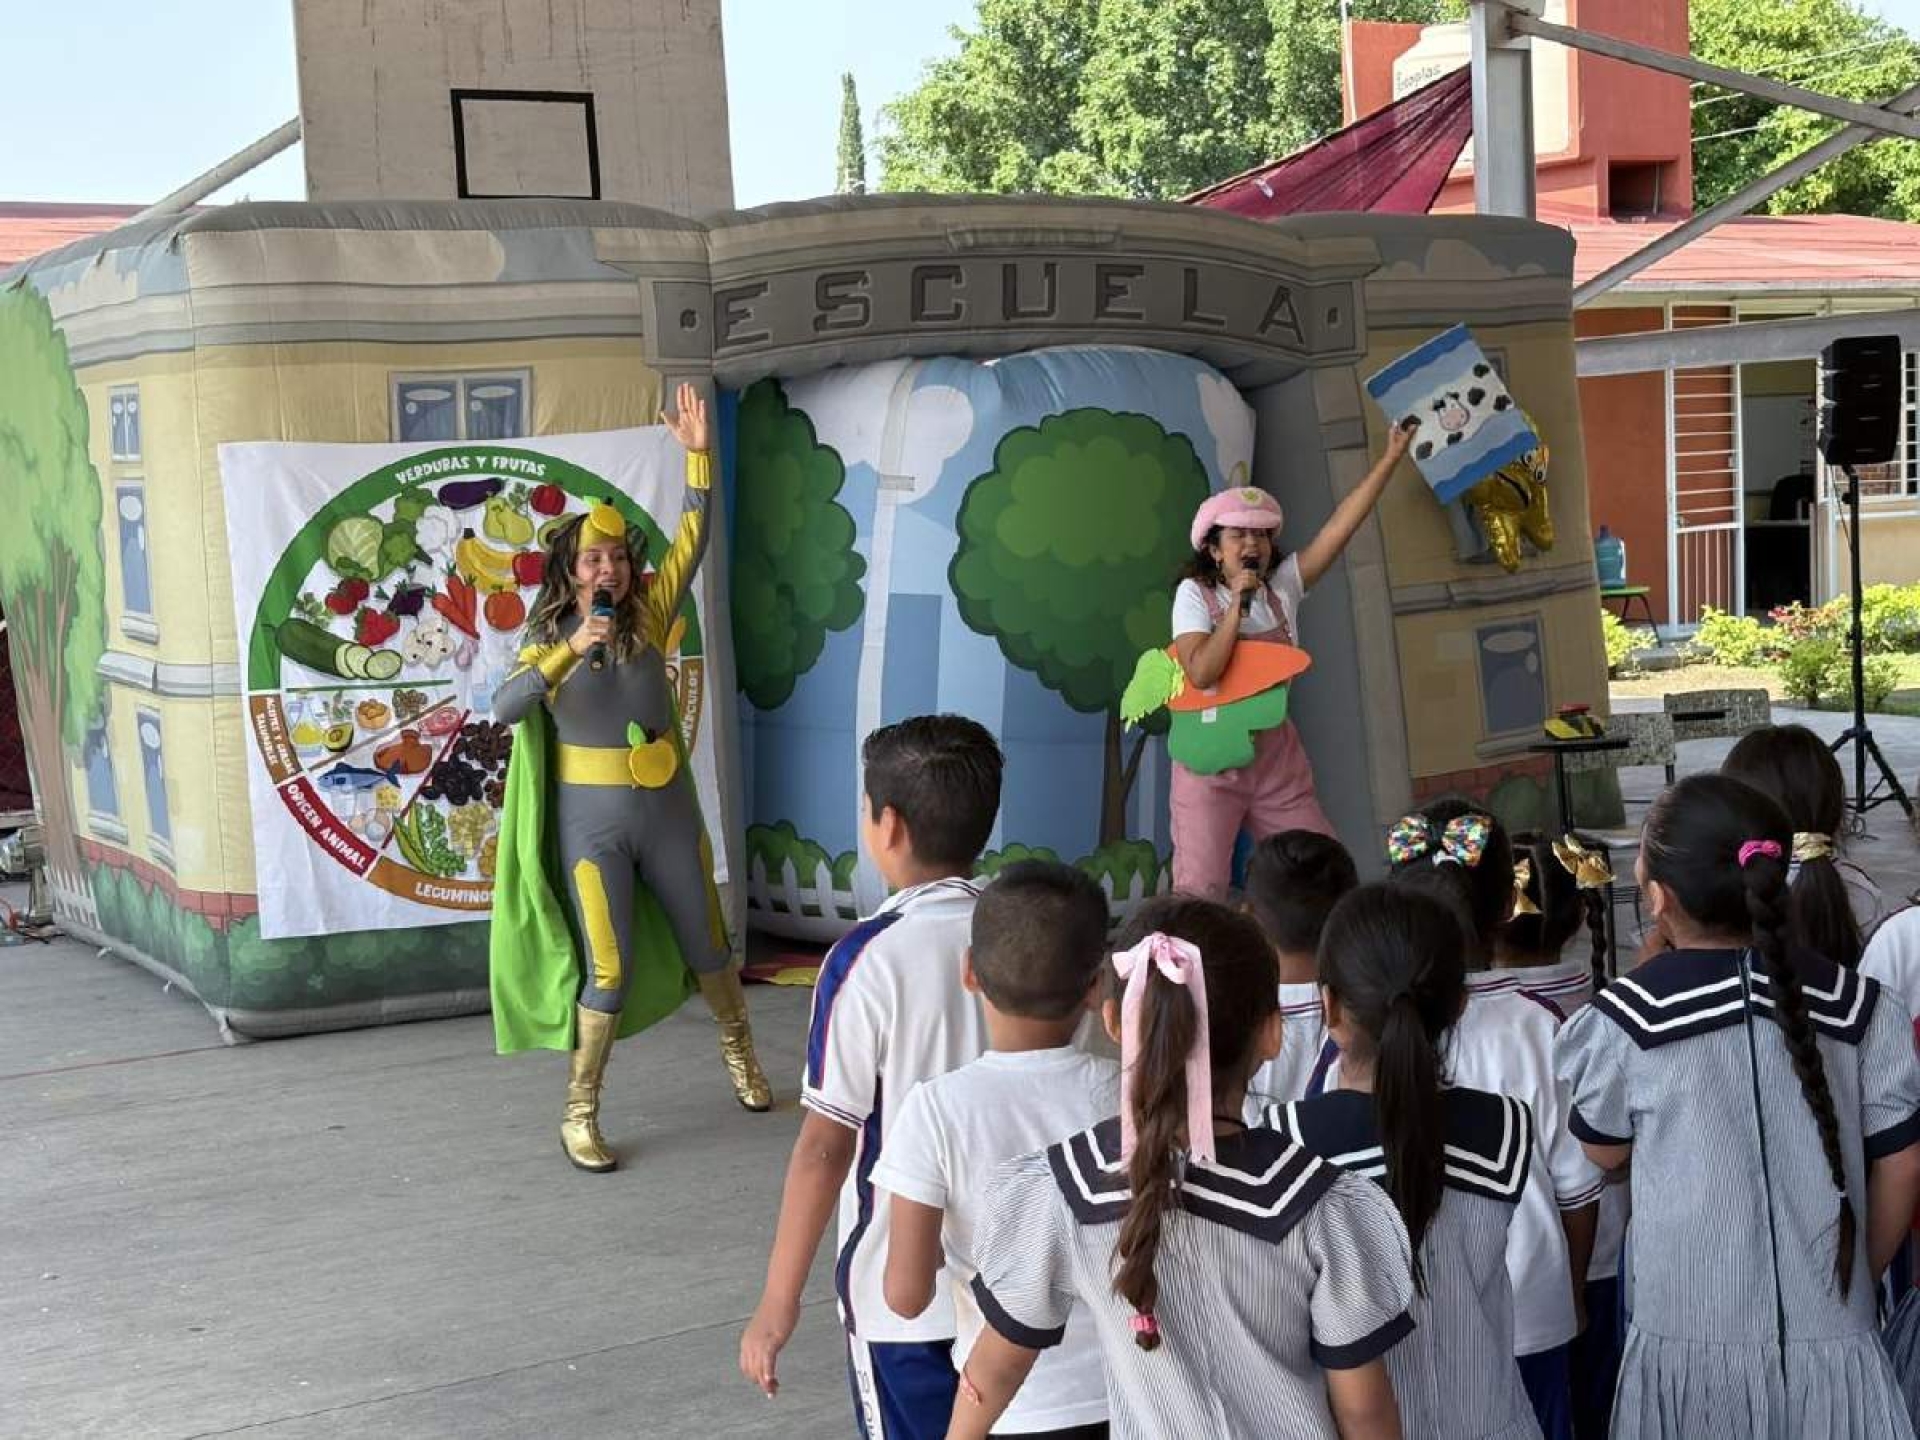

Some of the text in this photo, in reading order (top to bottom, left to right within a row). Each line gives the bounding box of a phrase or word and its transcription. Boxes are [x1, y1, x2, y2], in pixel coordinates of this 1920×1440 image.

[713, 263, 1305, 352] ESCUELA
[395, 456, 546, 484] VERDURAS Y FRUTAS
[288, 784, 366, 870] ORIGEN ANIMAL
